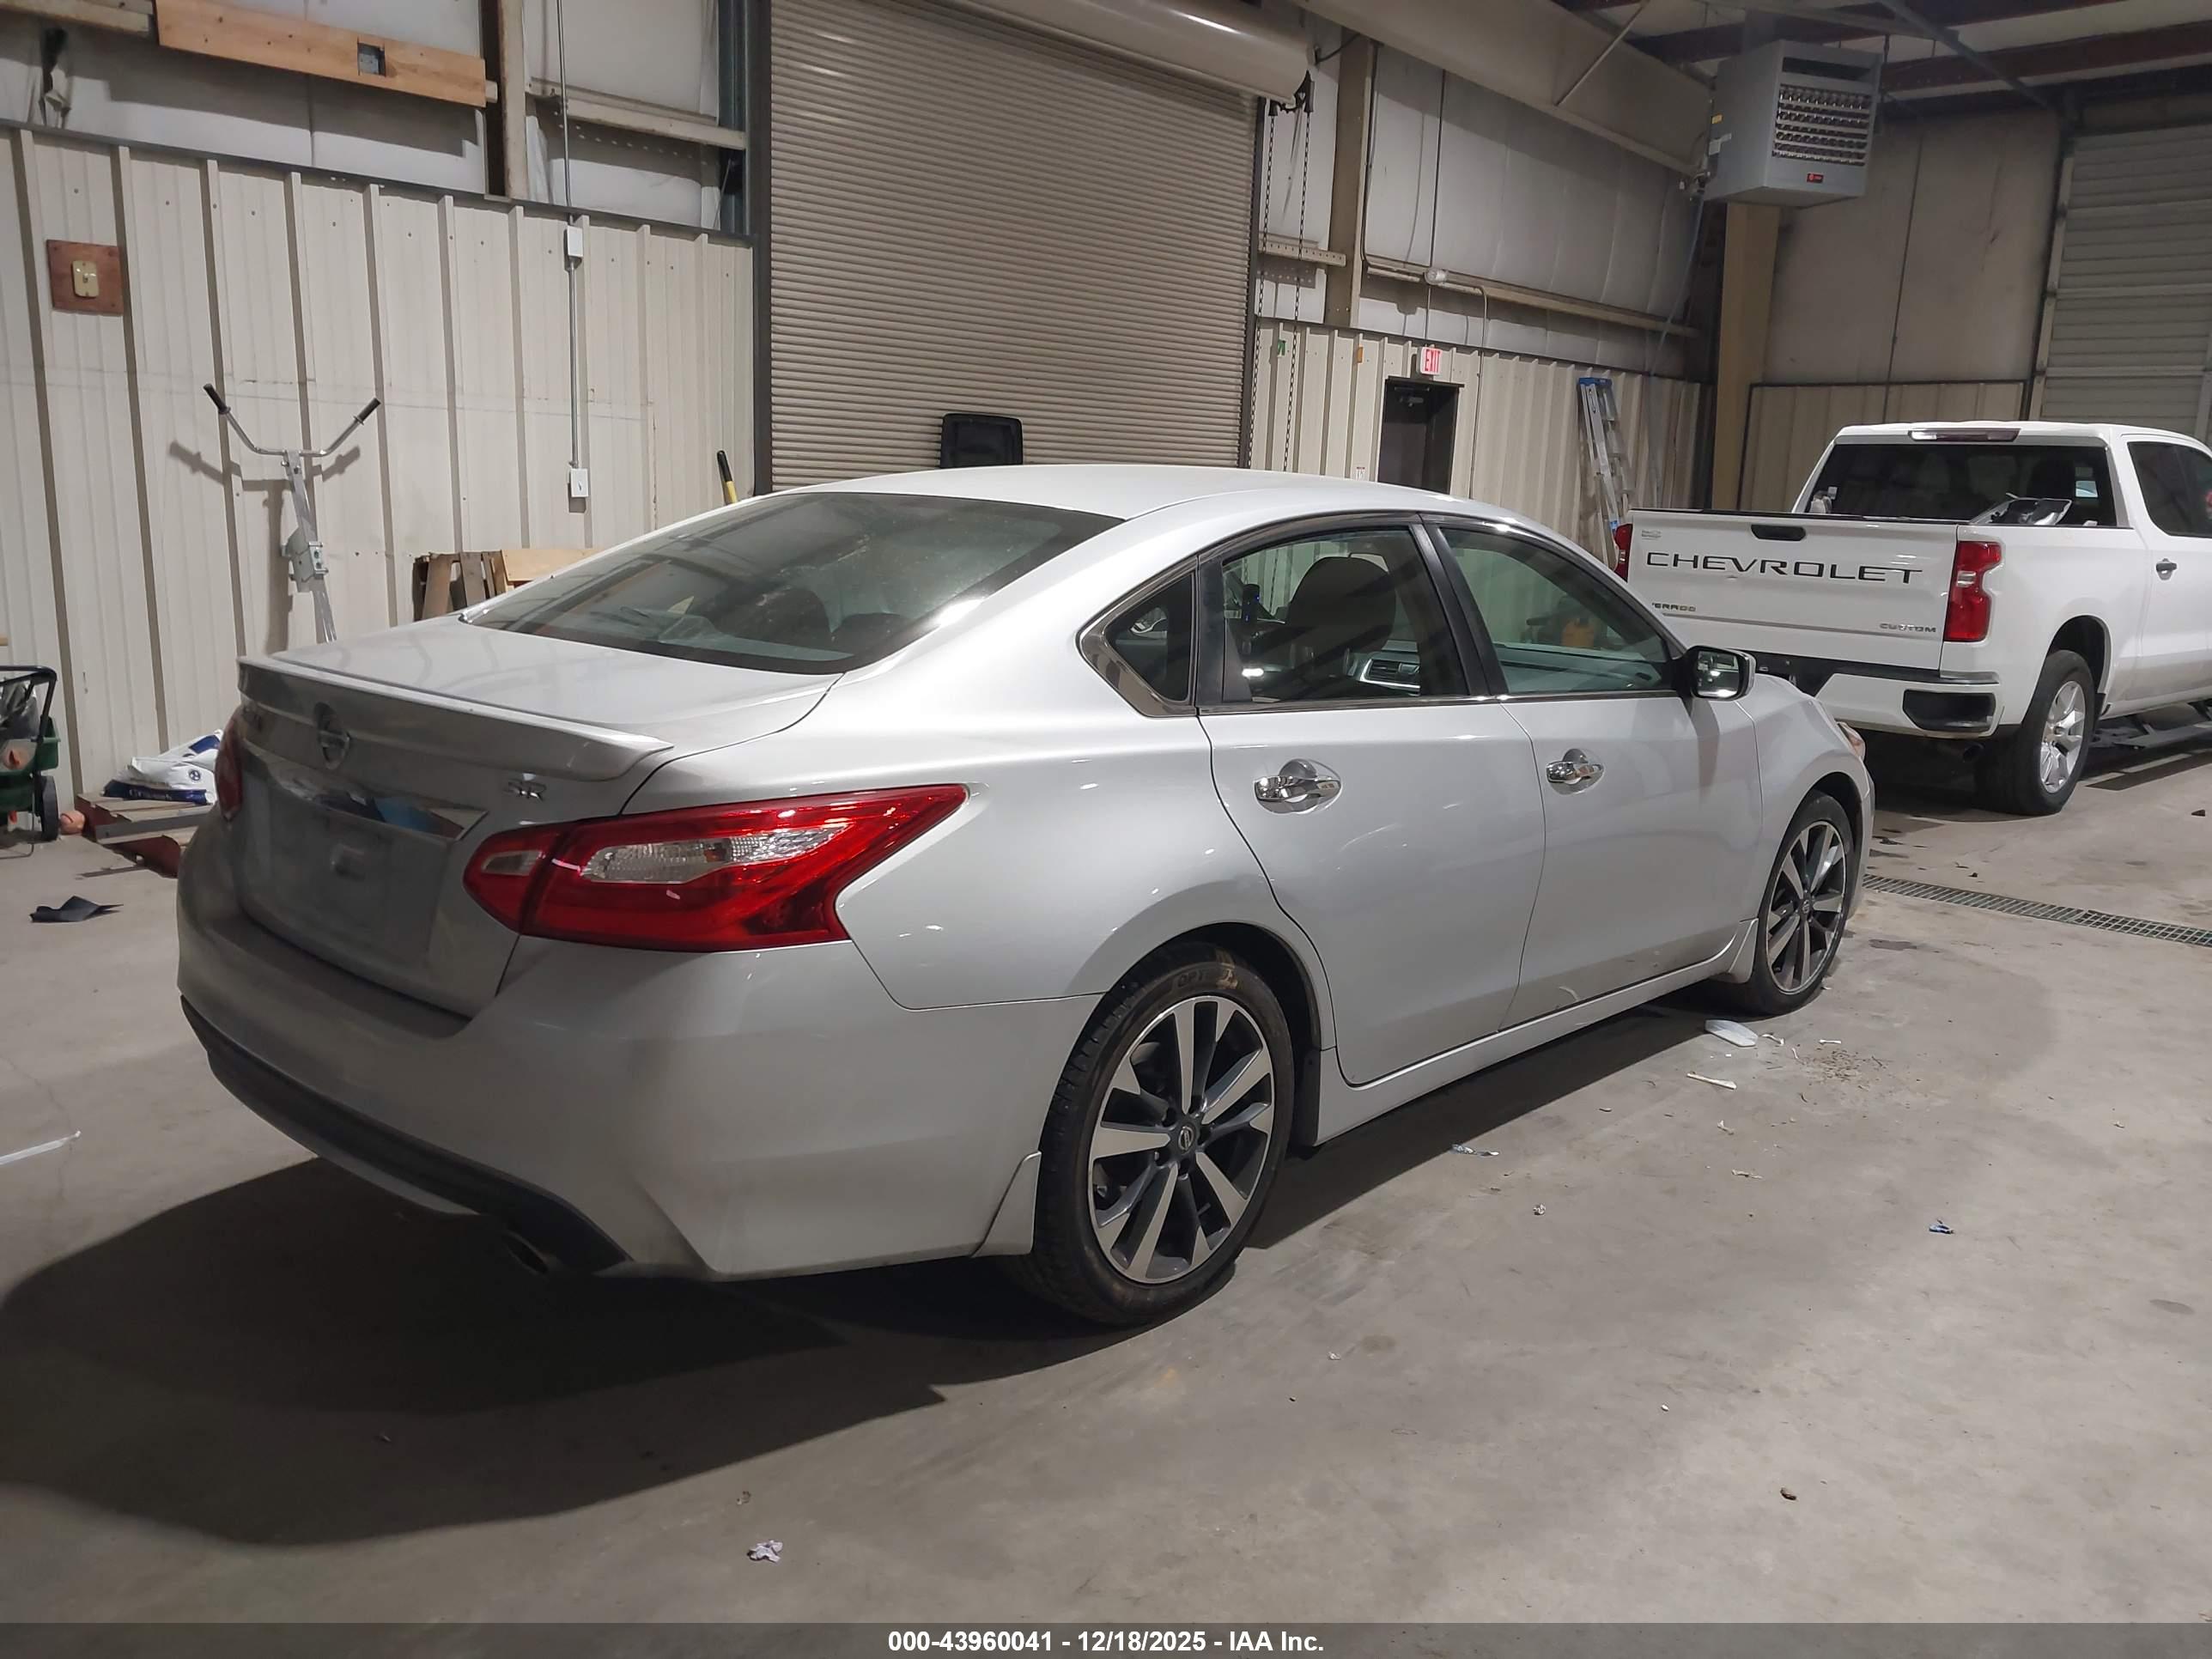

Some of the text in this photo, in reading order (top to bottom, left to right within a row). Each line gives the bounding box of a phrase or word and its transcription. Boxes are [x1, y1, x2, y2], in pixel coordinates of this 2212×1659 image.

[1425, 349, 1441, 373] EXIT
[1646, 552, 1923, 584] CHEVROLET
[1880, 623, 1936, 633] CUSTOM
